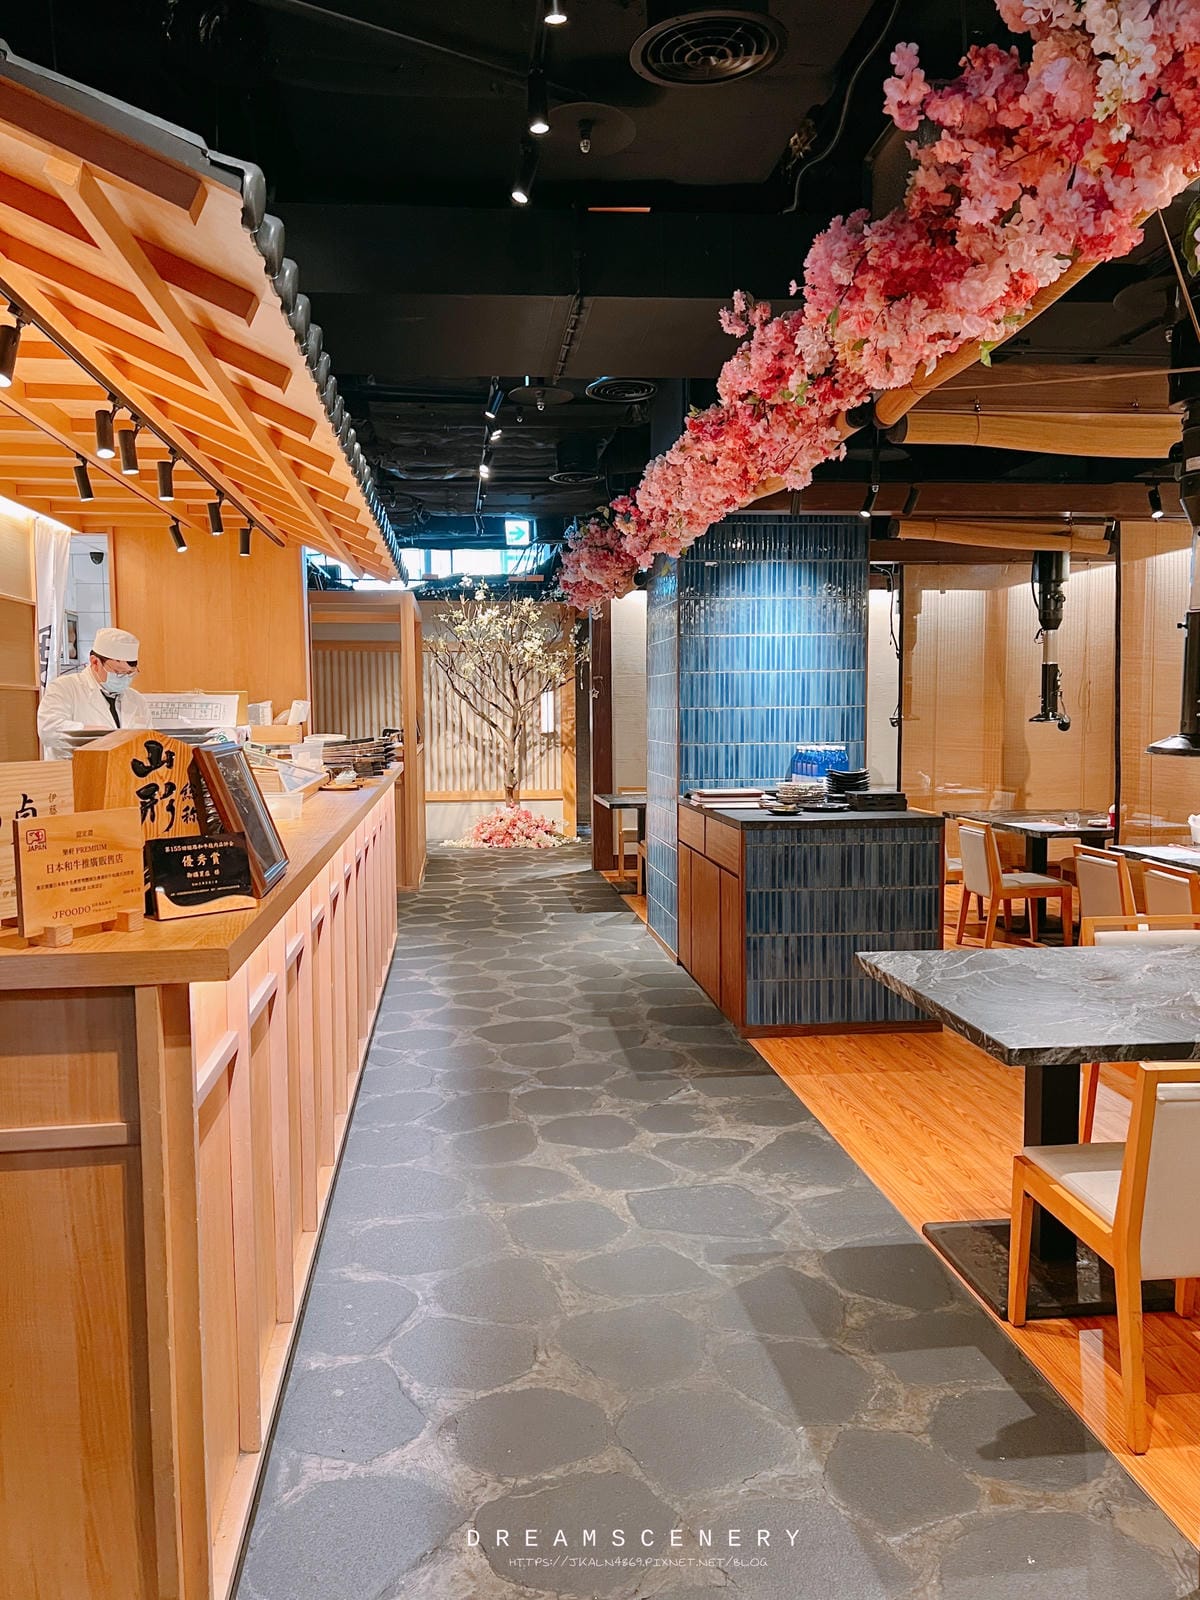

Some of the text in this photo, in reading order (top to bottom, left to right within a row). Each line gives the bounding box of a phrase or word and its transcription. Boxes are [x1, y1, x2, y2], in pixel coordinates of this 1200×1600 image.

[27, 845, 47, 853] JAPAN
[76, 843, 107, 855] PREMIUM
[182, 851, 220, 867] 優秀賞
